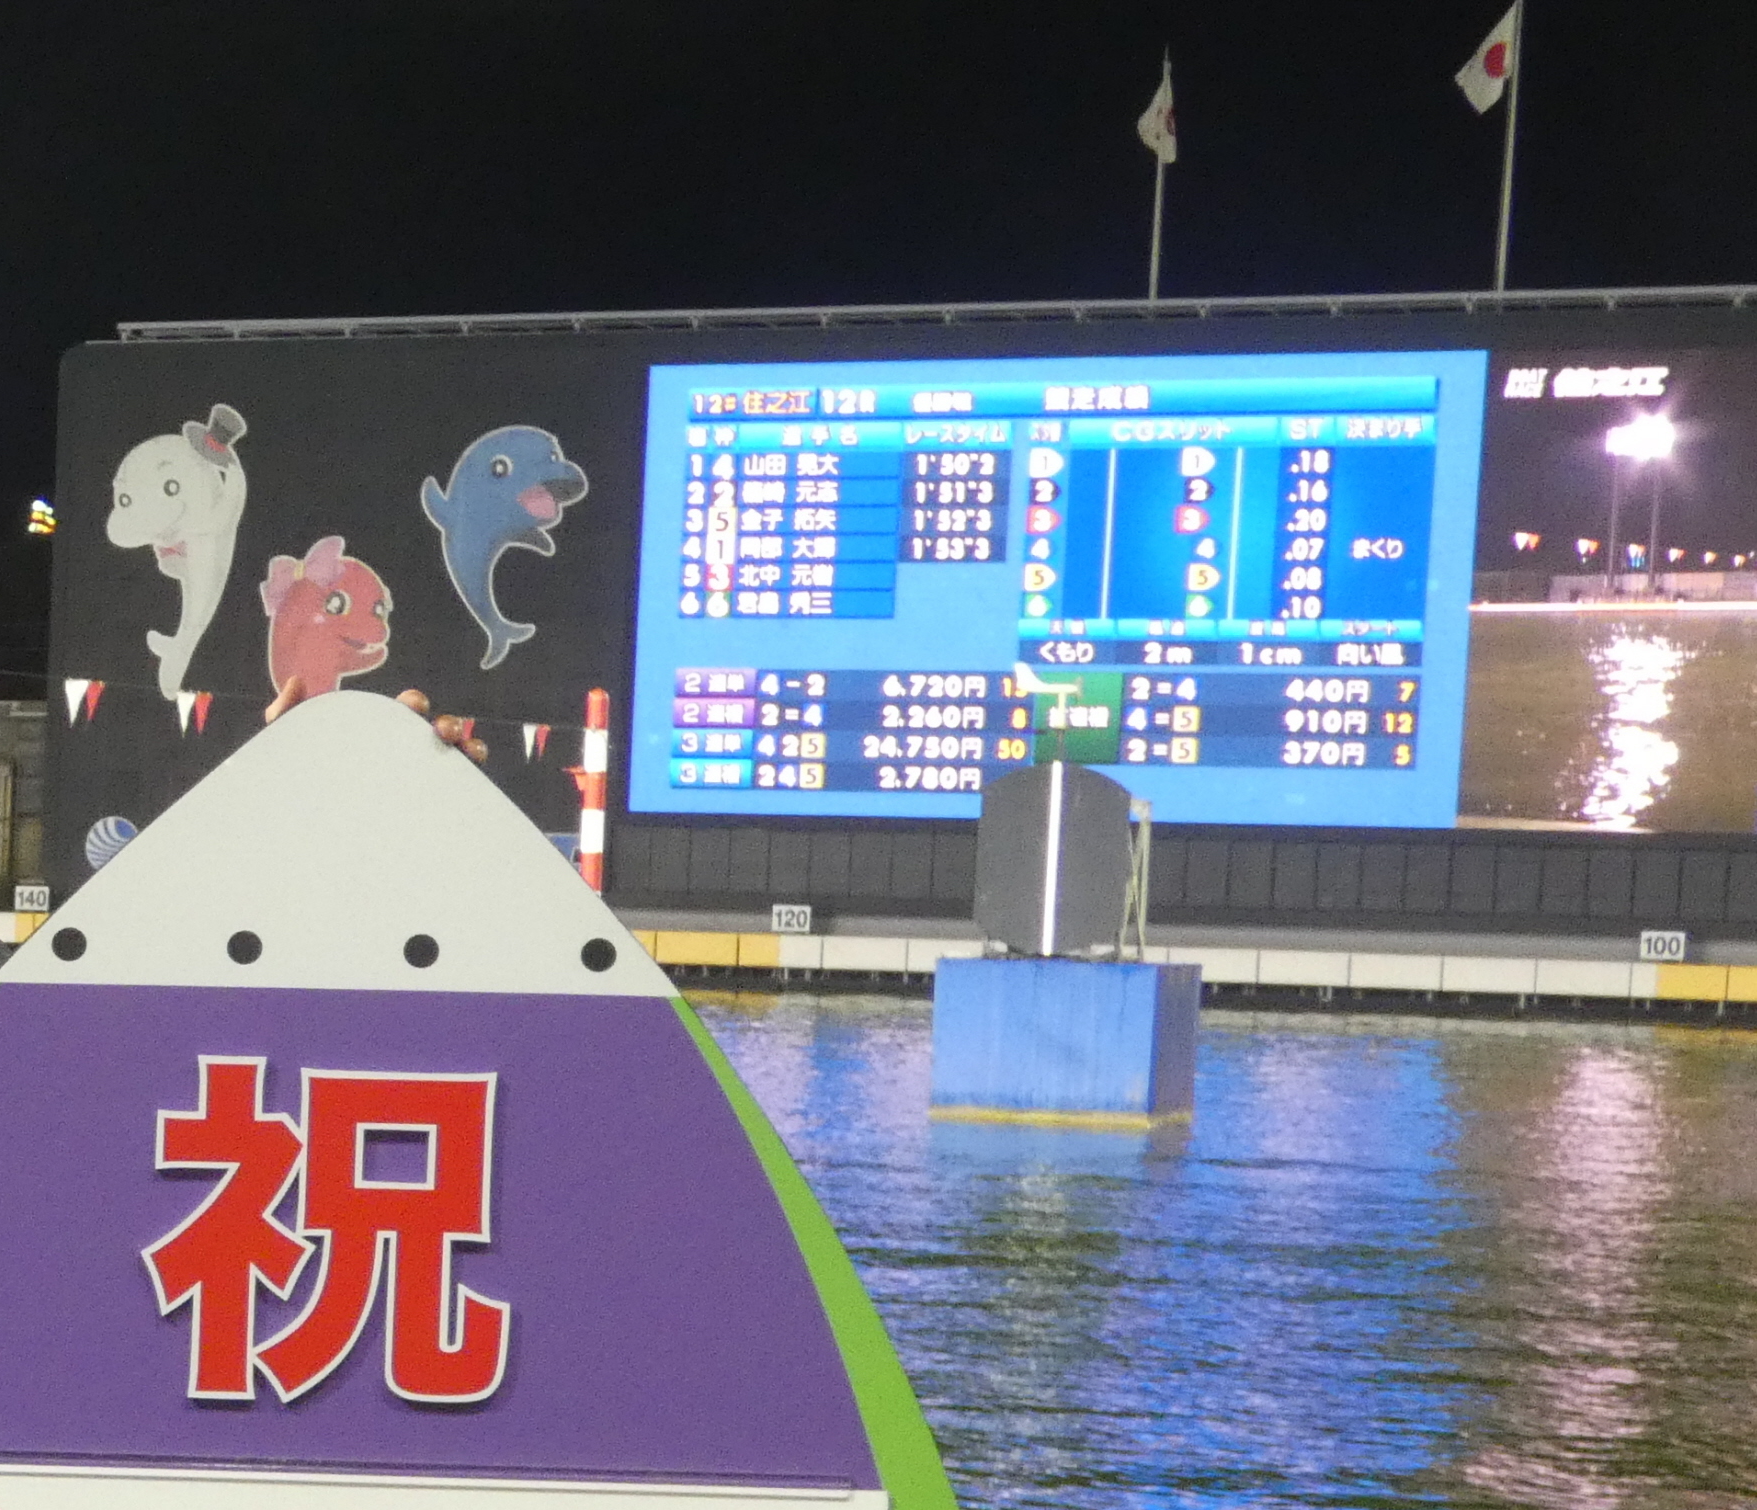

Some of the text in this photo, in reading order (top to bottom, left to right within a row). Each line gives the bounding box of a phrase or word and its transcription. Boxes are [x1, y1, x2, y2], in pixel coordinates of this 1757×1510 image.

[906, 423, 1006, 444] レースタイム
[1110, 419, 1231, 442] CGスリット
[1288, 417, 1325, 440] ST
[690, 453, 703, 477] 1
[711, 452, 736, 479] 4
[743, 453, 787, 477] 山田
[687, 480, 706, 505] 2
[712, 480, 736, 507] 2
[1034, 479, 1055, 503] 2
[1187, 478, 1208, 502] 2
[685, 507, 705, 533] 3
[715, 511, 729, 532] 5
[740, 507, 784, 532] 金子
[1033, 507, 1327, 533] 3 3 .20
[681, 535, 704, 560] 4
[717, 539, 724, 559] 1
[1030, 537, 1403, 561] 4 4 .07 まくり
[682, 563, 702, 588] 5
[708, 564, 730, 591] 3
[737, 563, 781, 587] 北中
[679, 591, 701, 615] 6
[1280, 595, 1322, 620] .10
[1039, 641, 1095, 664] くもり
[1143, 641, 1193, 664] 2m
[1239, 642, 1303, 665] 1cm
[1284, 677, 1371, 704] 440円
[1399, 680, 1415, 703] 7
[1283, 708, 1368, 735] 910円
[1384, 712, 1413, 734] 12
[1282, 740, 1366, 766] 370円
[18, 889, 47, 907] 140
[774, 909, 808, 929] 120
[1646, 935, 1681, 956] 100
[144, 1055, 510, 1403] 祝
